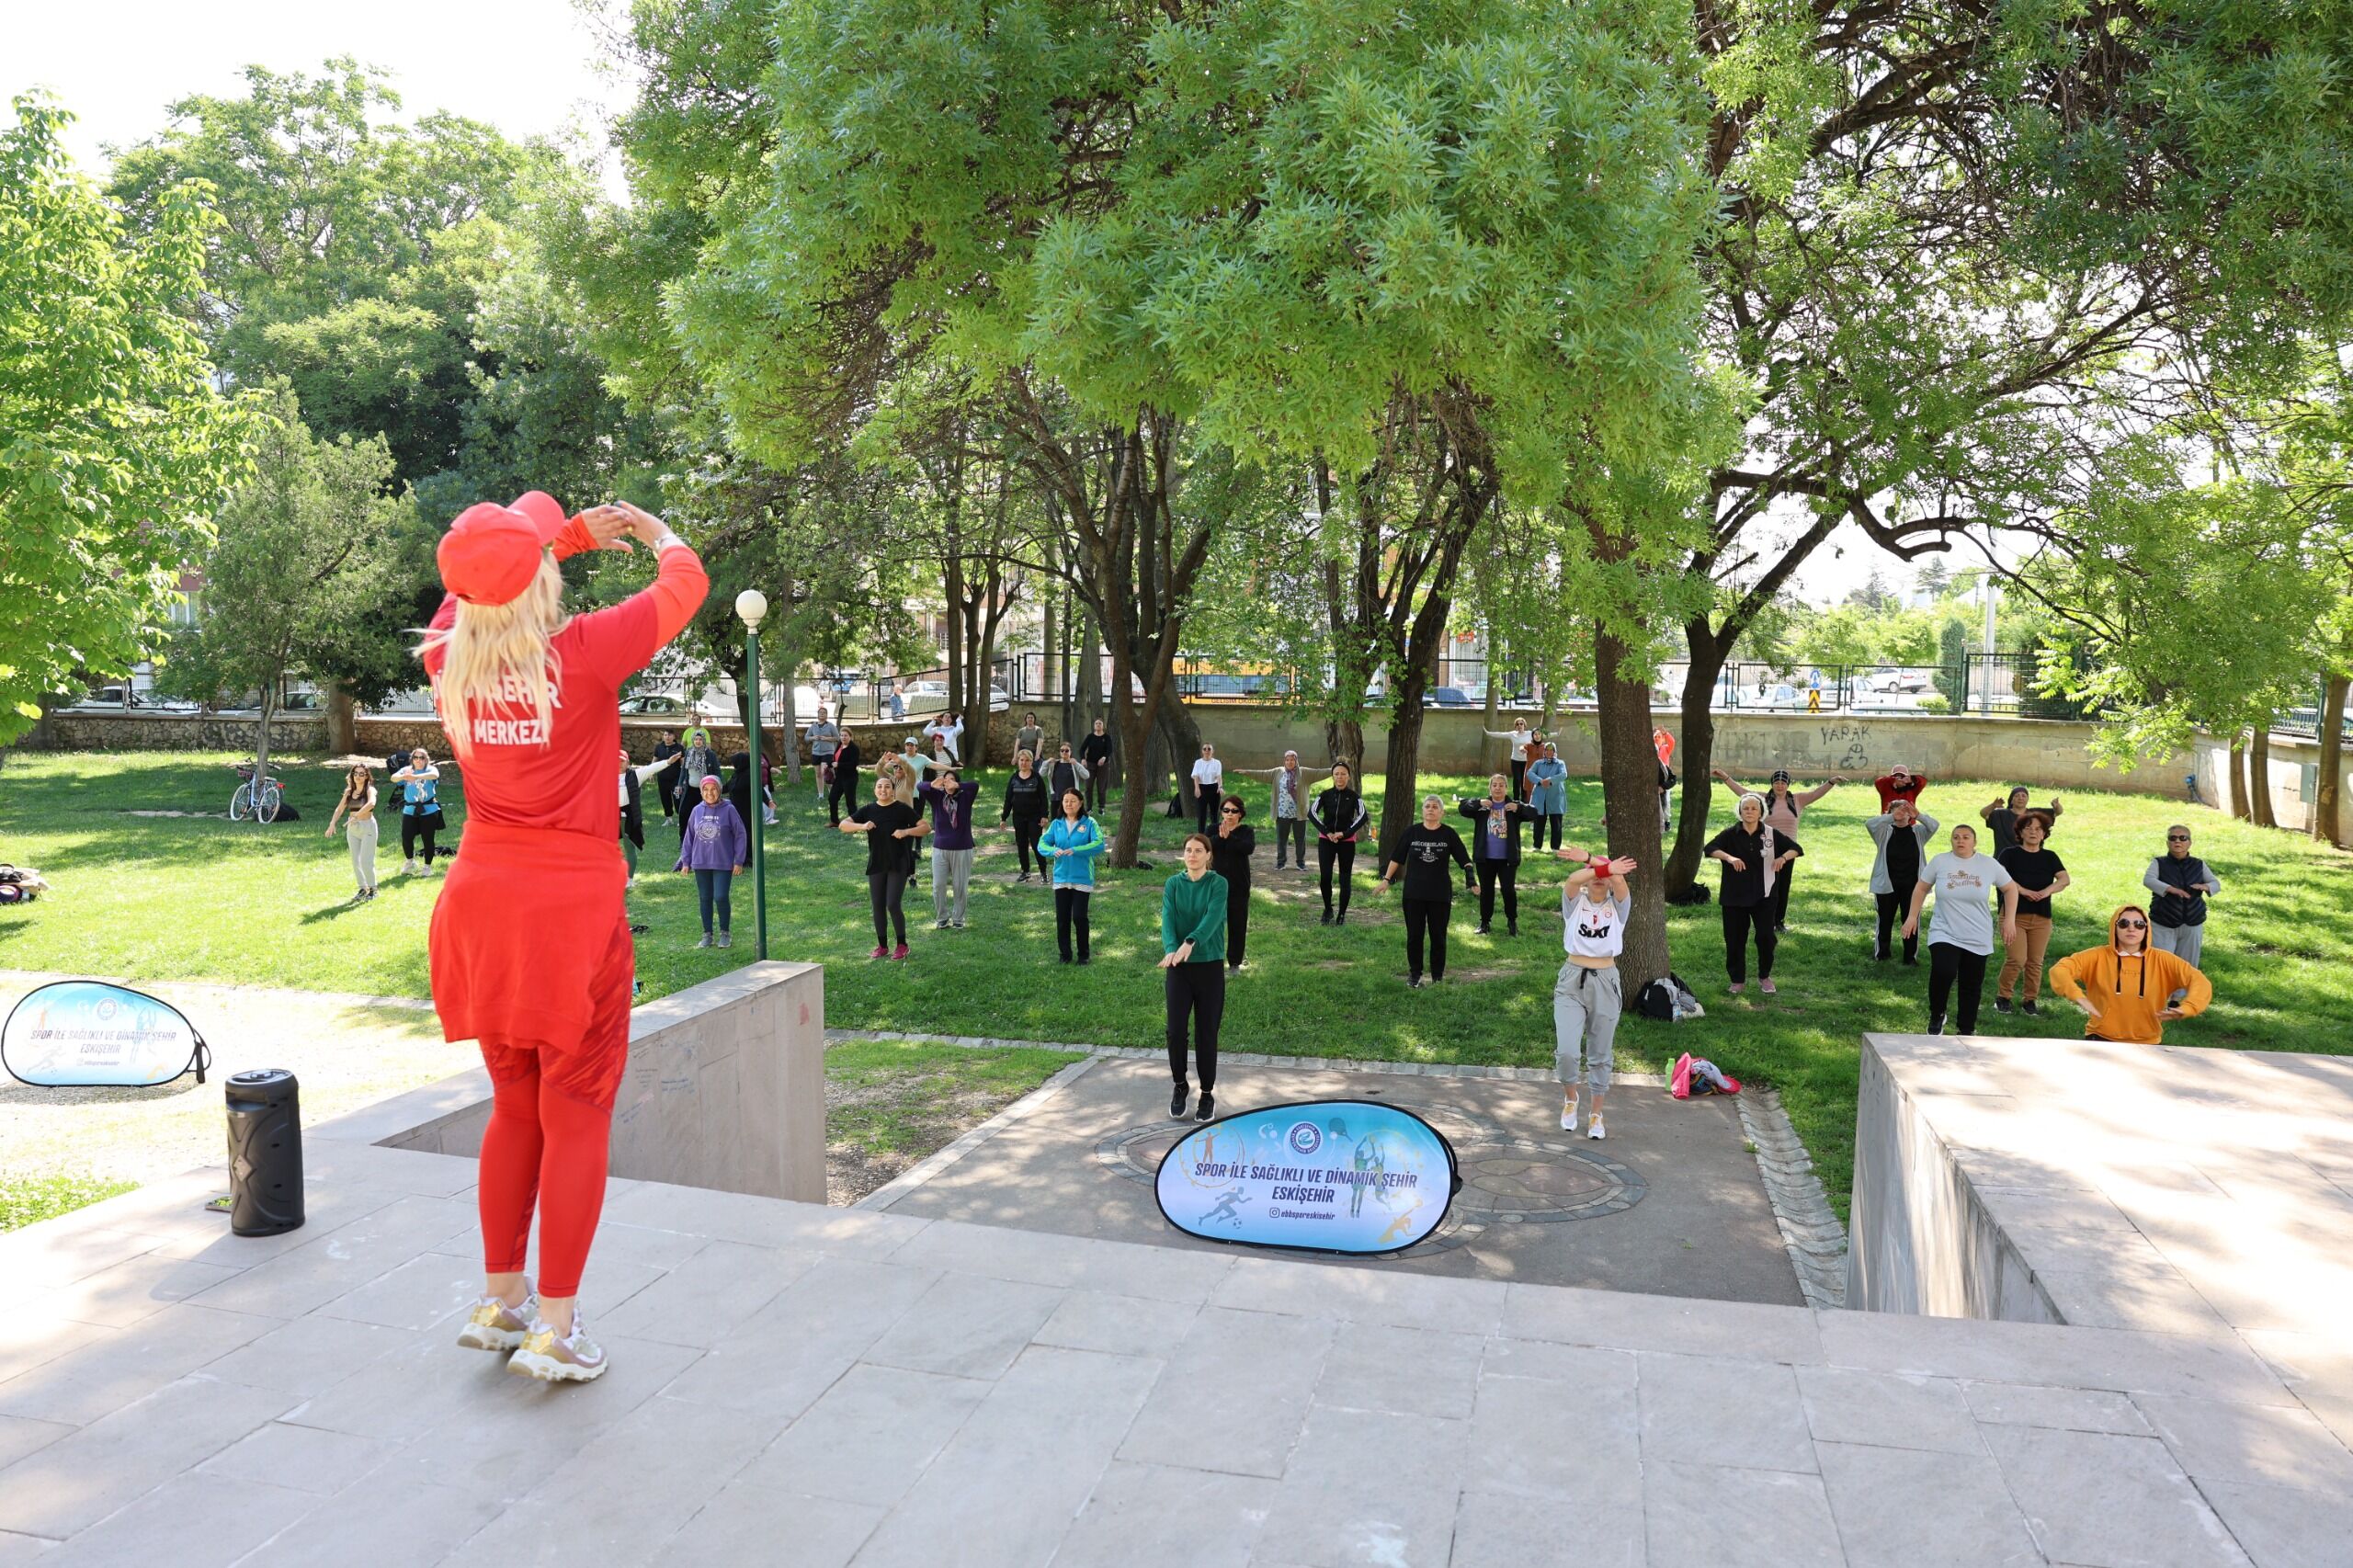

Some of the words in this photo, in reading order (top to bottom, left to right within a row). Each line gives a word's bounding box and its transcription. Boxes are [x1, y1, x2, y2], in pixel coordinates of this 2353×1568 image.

[473, 719, 551, 745] MERKEZ
[1821, 726, 1872, 745] YARAK
[30, 1029, 52, 1040] SPOR
[67, 1029, 103, 1040] SAĞLIKLI
[105, 1031, 115, 1040] VE
[1195, 1163, 1227, 1177] SPOR
[1230, 1162, 1248, 1178] İLE
[1250, 1164, 1303, 1182] SAĞLIKLI
[1308, 1169, 1323, 1183] VE
[1325, 1167, 1377, 1187] DİNAMİK
[1381, 1171, 1418, 1189] ŞEHİR
[1272, 1184, 1336, 1204] ESKİŞEHİR
